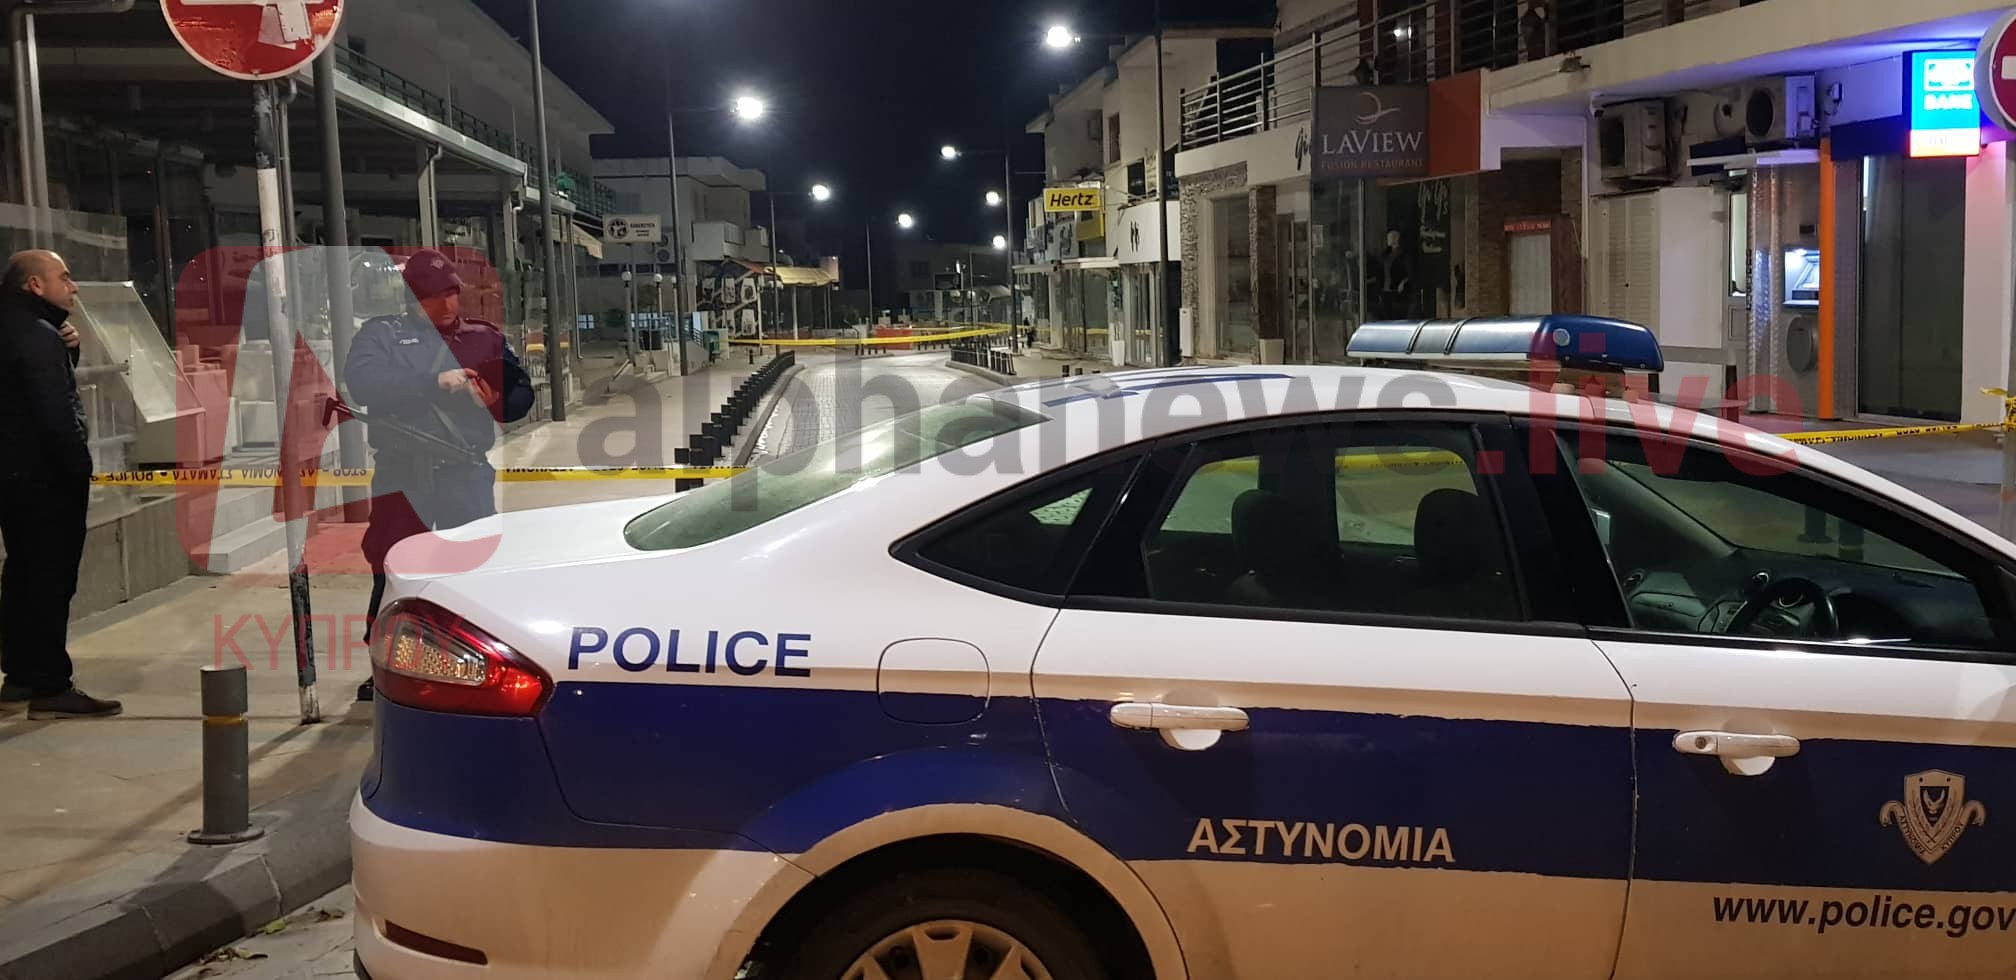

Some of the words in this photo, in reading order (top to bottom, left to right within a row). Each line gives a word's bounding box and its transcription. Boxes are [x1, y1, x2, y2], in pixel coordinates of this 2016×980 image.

[1321, 159, 1357, 169] FUSION
[1360, 158, 1424, 169] RESTAURANT
[1050, 192, 1094, 207] Hertz
[568, 626, 811, 677] POLICE
[1187, 817, 1456, 863] ΑΣΤΥΝΟΜΙΑ
[1713, 895, 2016, 938] www.police.gov
